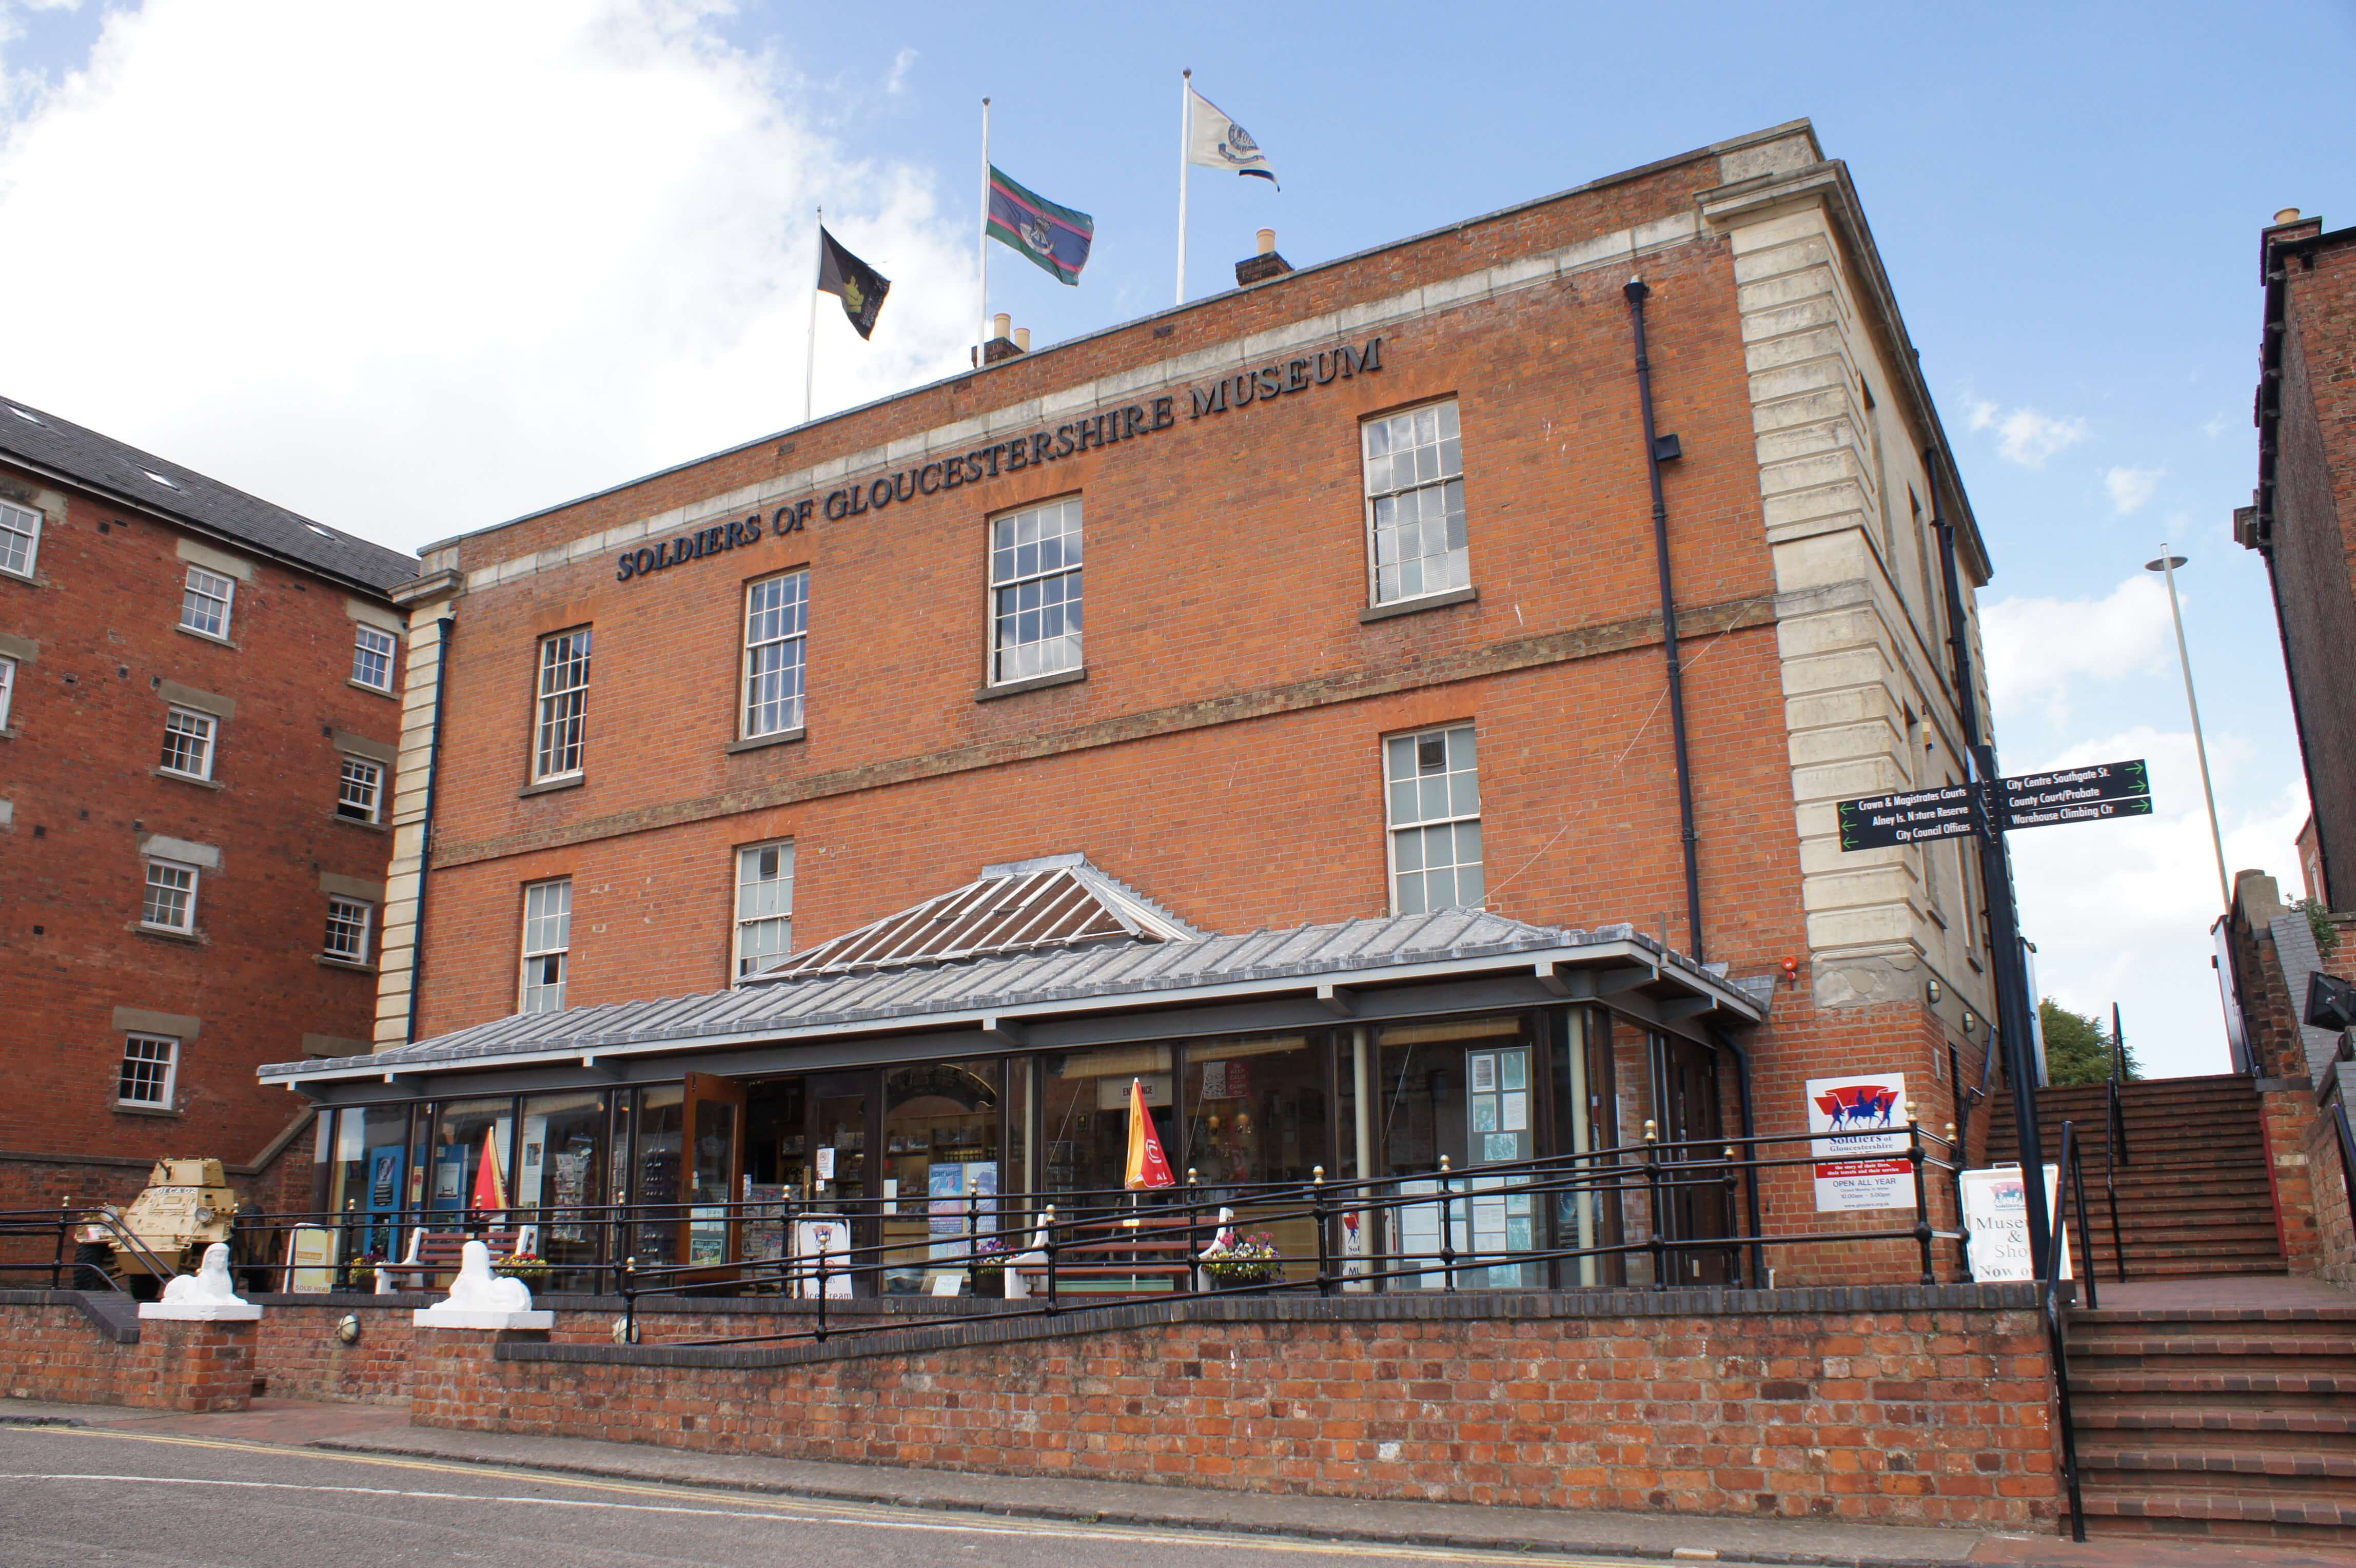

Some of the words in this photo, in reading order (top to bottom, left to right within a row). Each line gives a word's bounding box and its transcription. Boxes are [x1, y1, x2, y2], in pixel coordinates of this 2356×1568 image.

[617, 514, 761, 581] SOLDIERS
[772, 499, 813, 535] OF
[823, 396, 1175, 521] GLOUCESTERSHIRE
[1189, 337, 1383, 419] MUSEUM
[2006, 779, 2022, 791] City
[2024, 777, 2051, 788] Centre
[2052, 770, 2096, 783] Southgate
[2097, 767, 2111, 777] St.
[1858, 800, 1883, 811] Crown
[1884, 797, 1893, 807] &
[1894, 792, 1939, 807] Magistrates
[1940, 788, 1967, 799] Courts
[2009, 796, 2039, 807] County
[2039, 788, 2100, 803] Court/Probate
[1873, 815, 1895, 826] Alney
[1896, 813, 1907, 823] Is.
[1908, 810, 1936, 821] Nature
[1937, 806, 1969, 817] Reserve
[2011, 812, 2059, 825] Warehouse
[2060, 806, 2099, 819] Climbing
[2100, 804, 2114, 814] Ctr
[1896, 830, 1911, 841] City
[1913, 824, 1941, 837] Council
[1943, 822, 1971, 834] Offices
[1123, 1086, 1152, 1096] ENNCE
[1830, 1135, 1881, 1145] Soldiers
[1830, 1143, 1893, 1152] Gloucestershire
[2008, 1230, 2022, 1243] &
[1995, 1244, 2031, 1258] Sho
[1979, 1265, 2012, 1277] Now
[824, 1291, 852, 1299] ream
